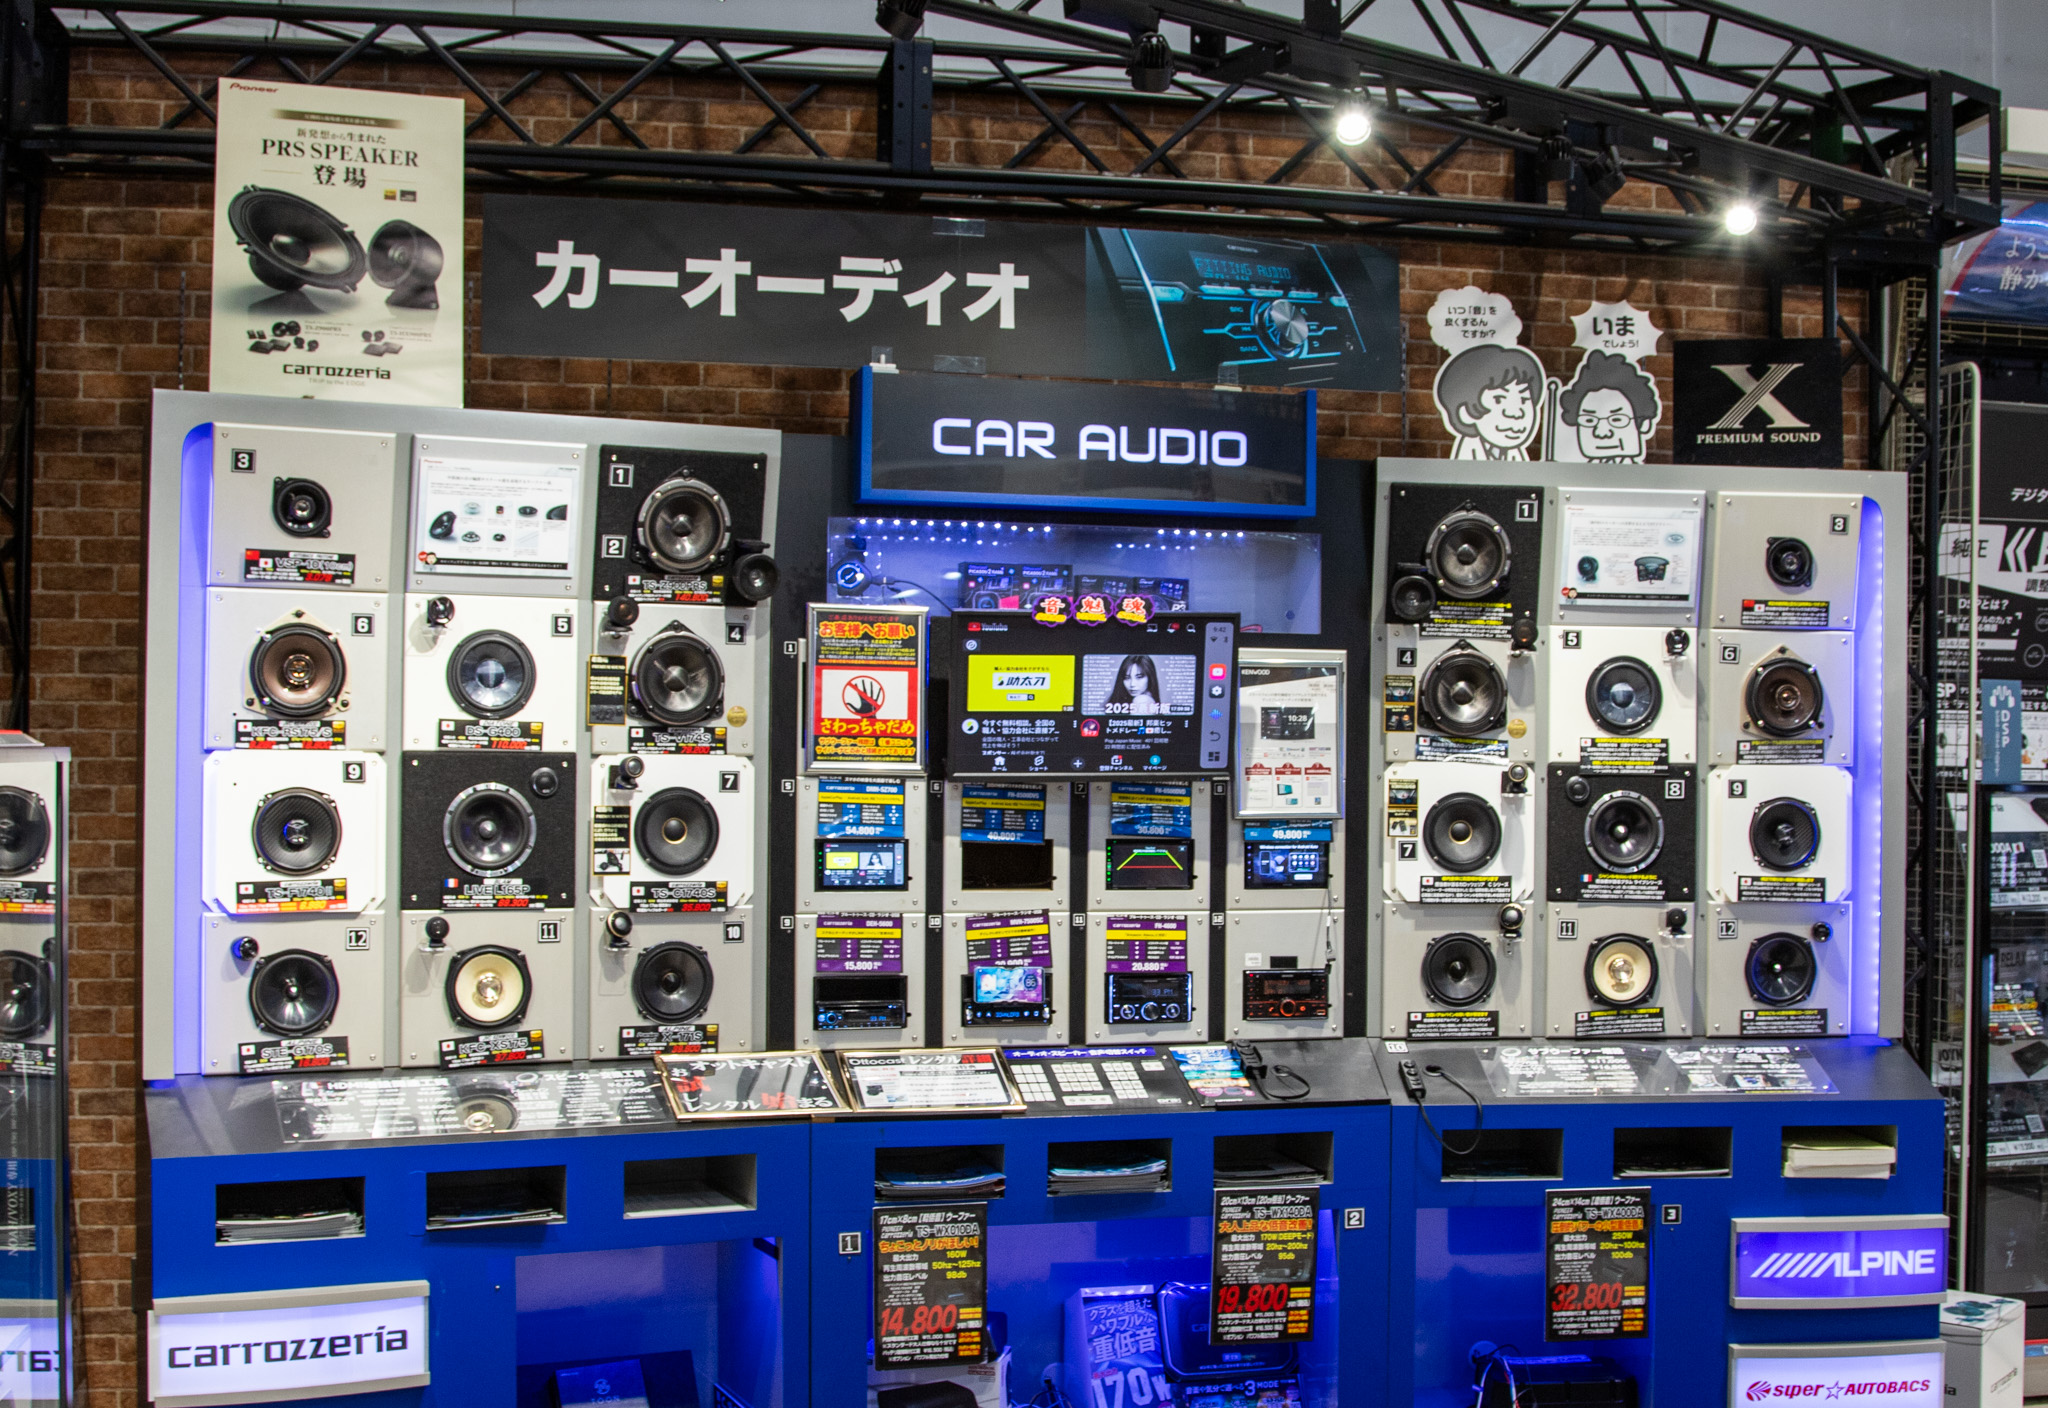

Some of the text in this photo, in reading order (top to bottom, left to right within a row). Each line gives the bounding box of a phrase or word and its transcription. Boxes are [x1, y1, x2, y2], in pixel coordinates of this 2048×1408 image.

[229, 82, 279, 94] Pioneer
[296, 128, 387, 144] 新発想から生まれた
[261, 138, 420, 168] PRS SPEAKER
[312, 164, 367, 189] 登場
[532, 240, 1030, 329] カーオーディオ
[1447, 304, 1498, 316] いつ「音」を
[1444, 318, 1488, 328] 良くするん
[1592, 316, 1636, 338] いま
[282, 363, 391, 380] carrozzeria
[1706, 363, 1810, 429] X
[932, 417, 1248, 468] CAR AUDIO
[1696, 432, 1821, 445] PREMIUM SOUND
[237, 453, 250, 468] 3
[616, 468, 624, 484] 1
[1521, 504, 1530, 518] 1
[1834, 518, 1844, 531] 3
[608, 540, 620, 554] 2
[1041, 597, 1065, 614] 音
[356, 618, 369, 632] 6
[557, 618, 568, 632] 5
[818, 621, 916, 639] お客様へお願い
[981, 623, 1008, 631] YouTube
[730, 629, 741, 641] 4
[1567, 632, 1578, 646] 5
[1402, 651, 1412, 664] 4
[1724, 648, 1735, 660] 6
[1240, 668, 1271, 676] KENWOOD
[1006, 676, 1046, 686] 助太刀
[1105, 702, 1171, 715] 2025最新版
[981, 718, 1056, 727] 今すぐ無料相談。全国の
[1288, 714, 1308, 722] 10:28
[465, 726, 522, 737] DS-G400
[820, 718, 915, 734] さわっちゃだめ
[348, 764, 362, 780] 9
[724, 775, 736, 788] 7
[1078, 784, 1084, 792] 7
[1668, 783, 1681, 796] 8
[1732, 782, 1744, 796] 9
[845, 826, 874, 836] 54,800
[1272, 830, 1302, 840] 49,800
[1402, 844, 1414, 857] 7
[464, 884, 492, 896] LIVE
[542, 924, 556, 939] 11
[726, 926, 740, 938] 10
[1561, 922, 1573, 936] 11
[1720, 922, 1736, 936] 12
[349, 931, 367, 946] 12
[844, 961, 873, 971] 15,800
[661, 1032, 703, 1042] X-171S
[690, 1058, 812, 1071] オットキャスト
[848, 1058, 906, 1066] Ottocast
[1286, 1194, 1310, 1204] ウーファー
[1614, 1196, 1641, 1204] ウーファー
[946, 1212, 976, 1222] ウーファー
[1253, 1206, 1313, 1219] TS-WX140DA
[1349, 1212, 1360, 1226] 2
[1584, 1206, 1645, 1220] TS-WX400DA
[1666, 1208, 1677, 1220] 3
[915, 1223, 980, 1238] TS-WX010DA
[844, 1236, 854, 1251] 1
[1221, 1253, 1264, 1262] 出力音圧レベル
[1554, 1252, 1597, 1261] 出力音圧レベル
[1811, 1248, 1936, 1278] ALPINE
[882, 1274, 929, 1282] 出力音圧レベル
[1217, 1283, 1289, 1313] 19,800
[1552, 1282, 1623, 1312] 32,800
[1088, 1298, 1152, 1322] クラスを超えた
[880, 1304, 958, 1336] 14,800
[1090, 1312, 1158, 1336] パワフルな
[168, 1325, 408, 1369] carrozzeria
[1092, 1326, 1157, 1364] 重低音
[1773, 1379, 1931, 1398] super AUTOBACS
